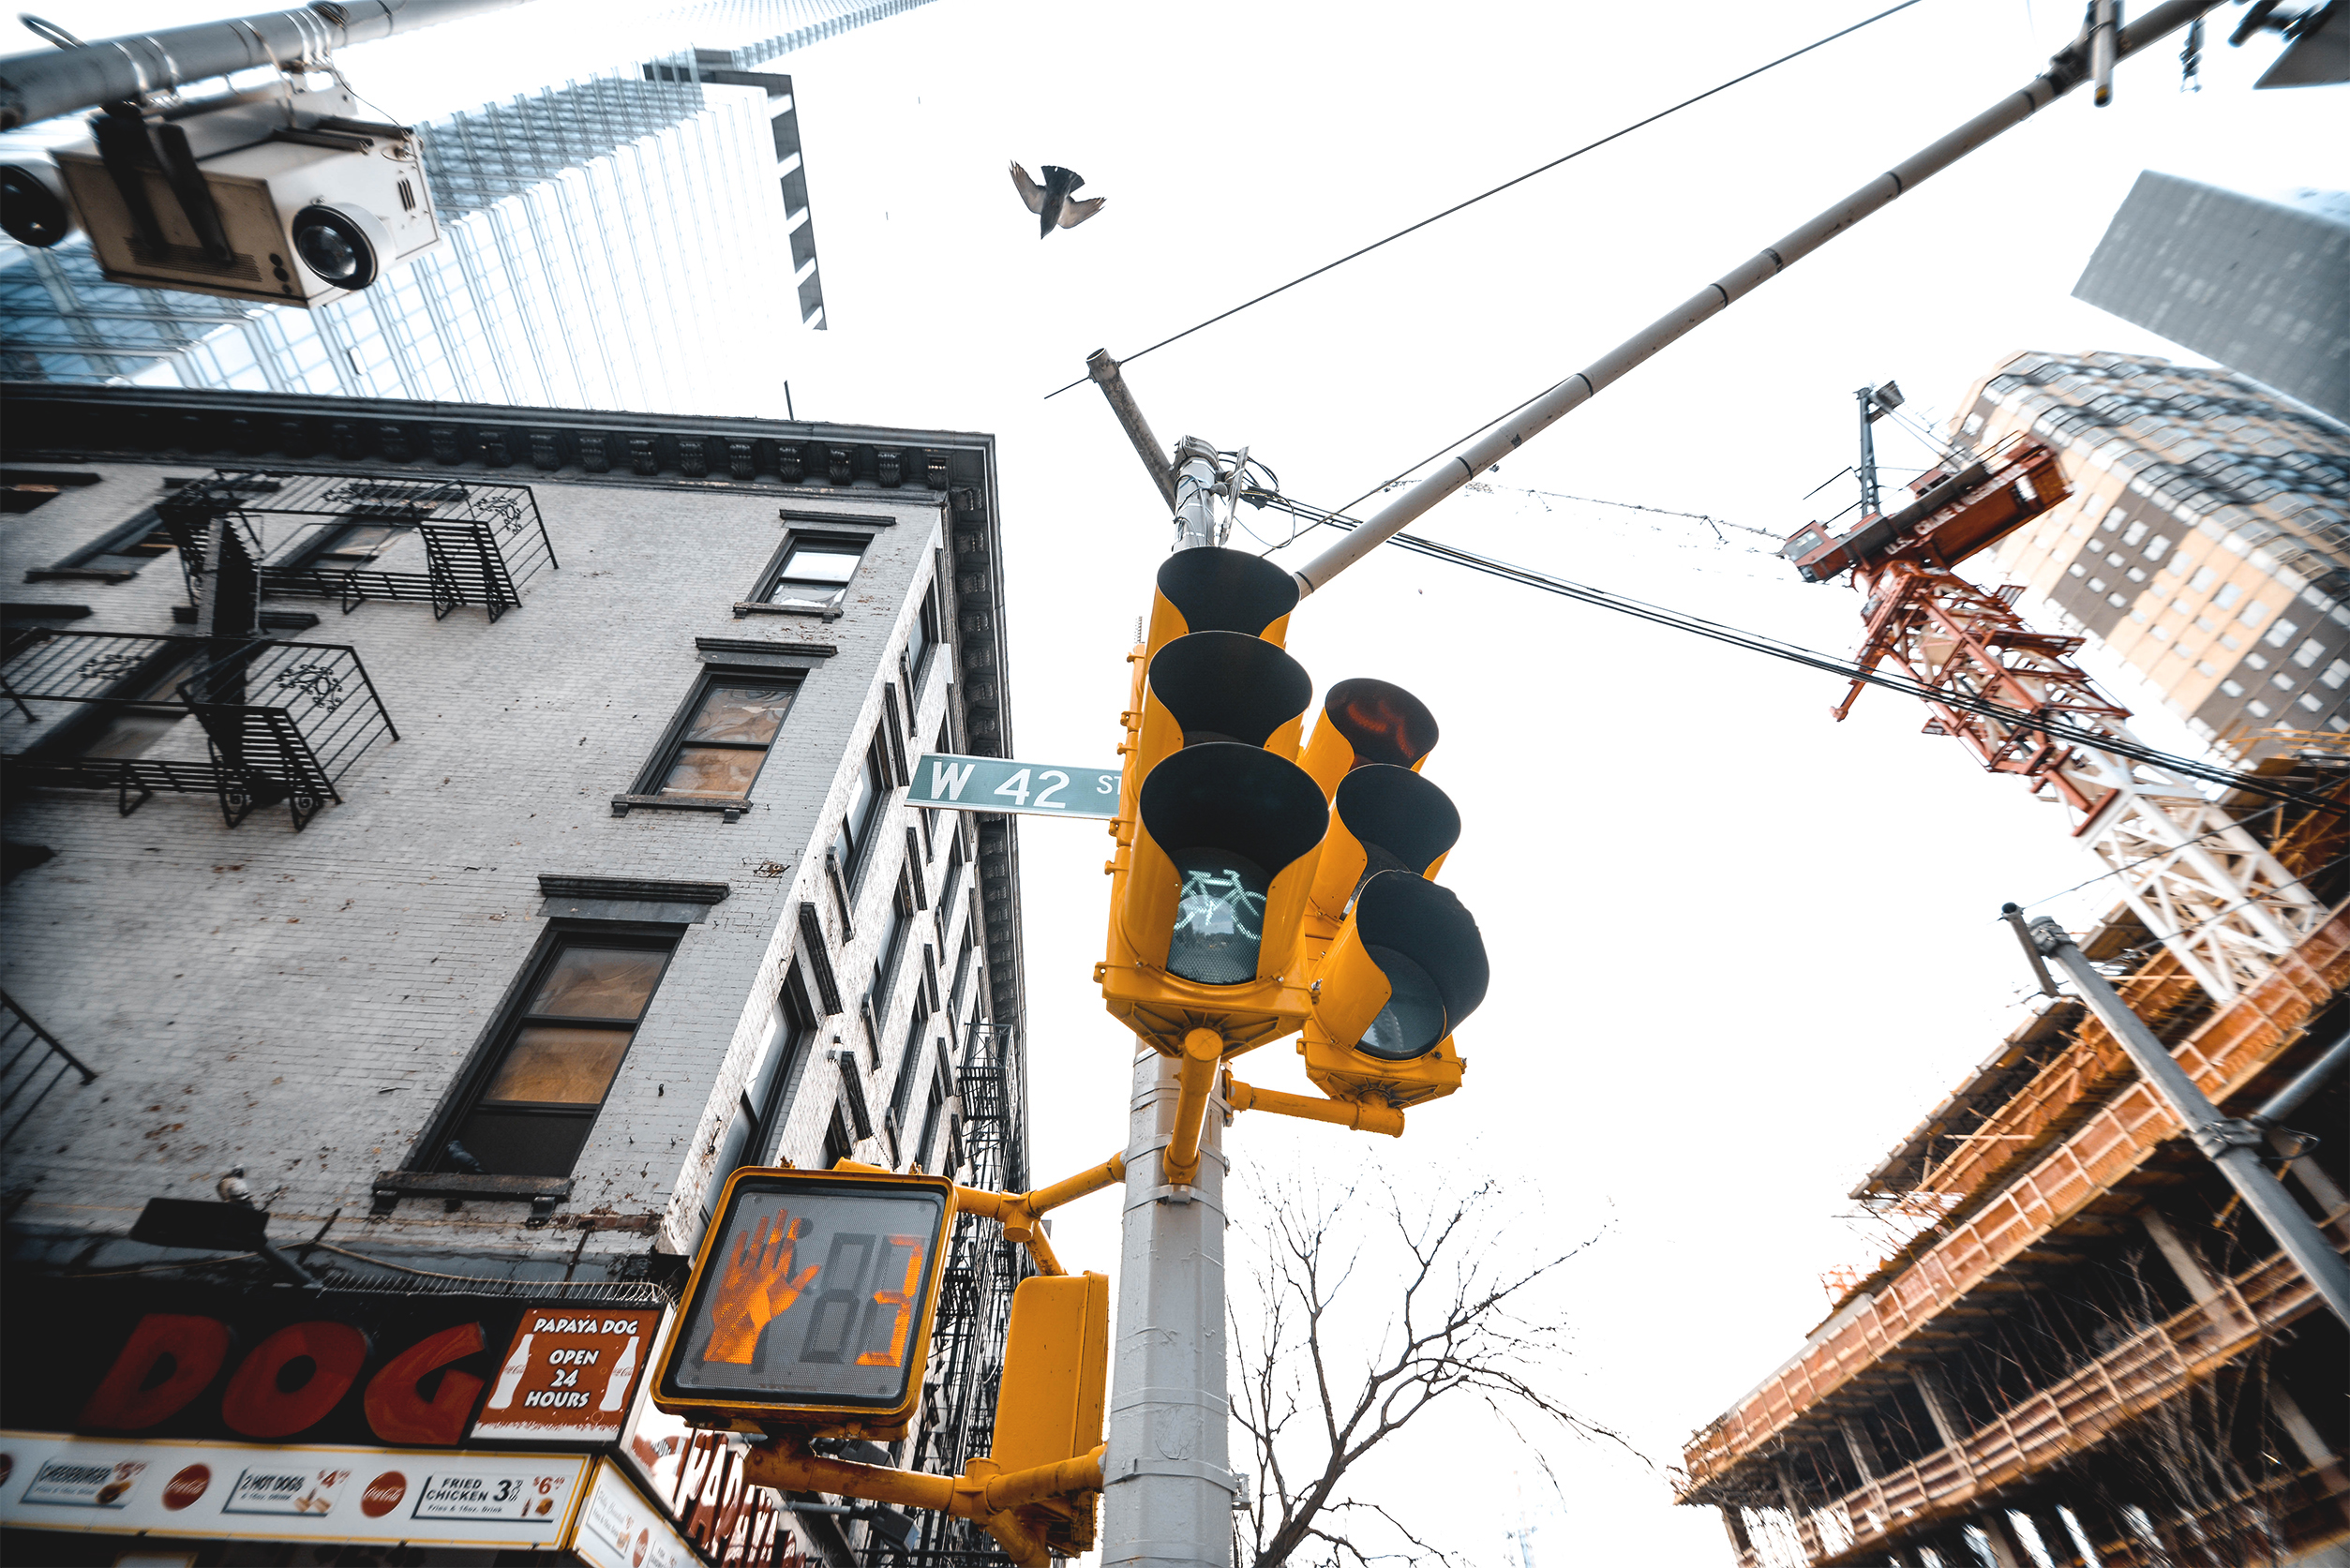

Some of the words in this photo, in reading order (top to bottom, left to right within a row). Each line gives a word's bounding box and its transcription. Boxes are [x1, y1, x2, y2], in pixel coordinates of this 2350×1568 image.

[1914, 508, 1958, 535] CRANE
[931, 761, 976, 801] W
[994, 769, 1070, 809] 42
[533, 1318, 598, 1334] PAPAYA
[601, 1319, 638, 1335] DOG
[548, 1349, 600, 1366] OPEN
[77, 1313, 485, 1445] DOG
[550, 1368, 579, 1388] 24
[524, 1391, 591, 1408] HOURS
[240, 1474, 252, 1490] 2
[249, 1474, 277, 1491] HOT
[273, 1475, 306, 1492] DOGS
[442, 1478, 483, 1488] FRIED
[492, 1479, 513, 1501] 3
[426, 1489, 489, 1501] CHICKEN
[427, 1504, 448, 1513] Fries
